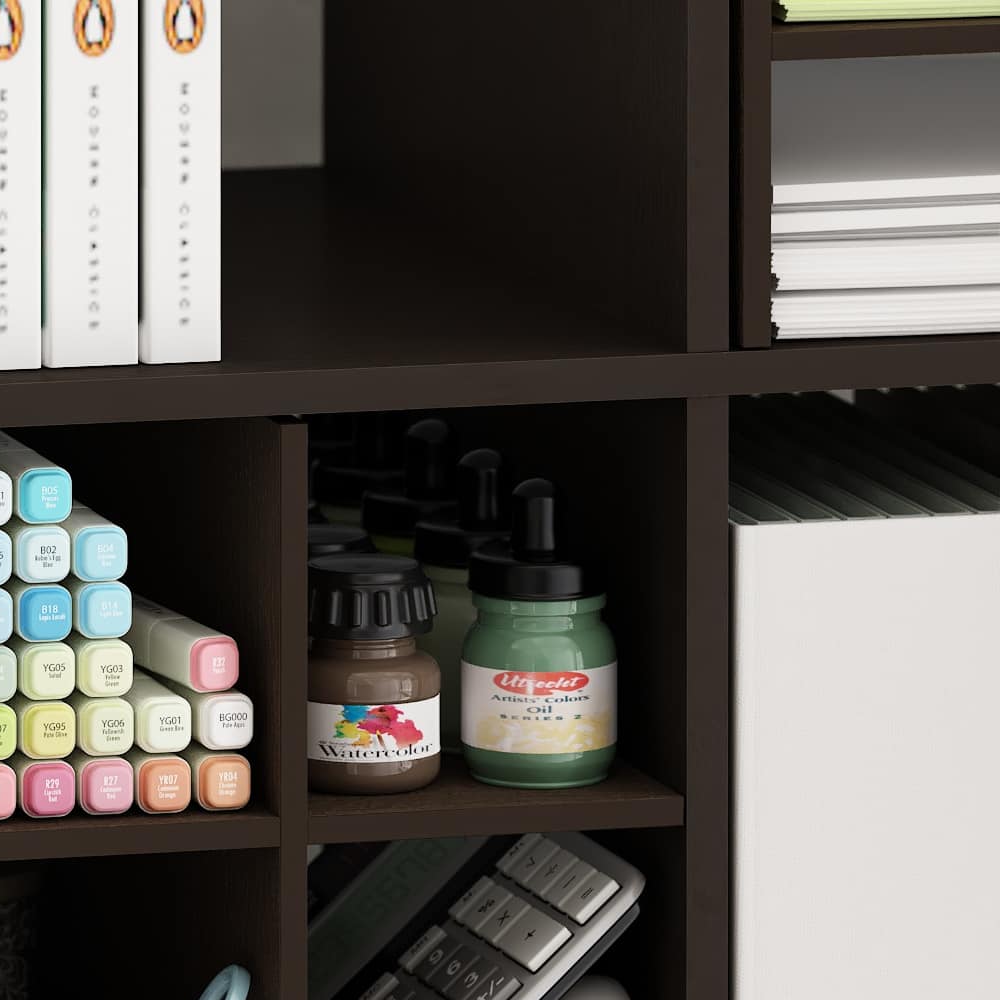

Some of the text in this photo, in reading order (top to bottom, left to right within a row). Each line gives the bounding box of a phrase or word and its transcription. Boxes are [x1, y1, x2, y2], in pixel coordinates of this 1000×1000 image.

[41, 546, 56, 554] B02
[42, 606, 58, 614] B18
[43, 663, 65, 672] YG05
[101, 665, 123, 673] YG03
[544, 694, 591, 703] Colors
[527, 705, 552, 713] Oil
[160, 716, 181, 725] YG01
[220, 713, 247, 721] BG000
[44, 723, 66, 731] YG95
[102, 720, 124, 728] YG06
[318, 743, 433, 758] Watercolor
